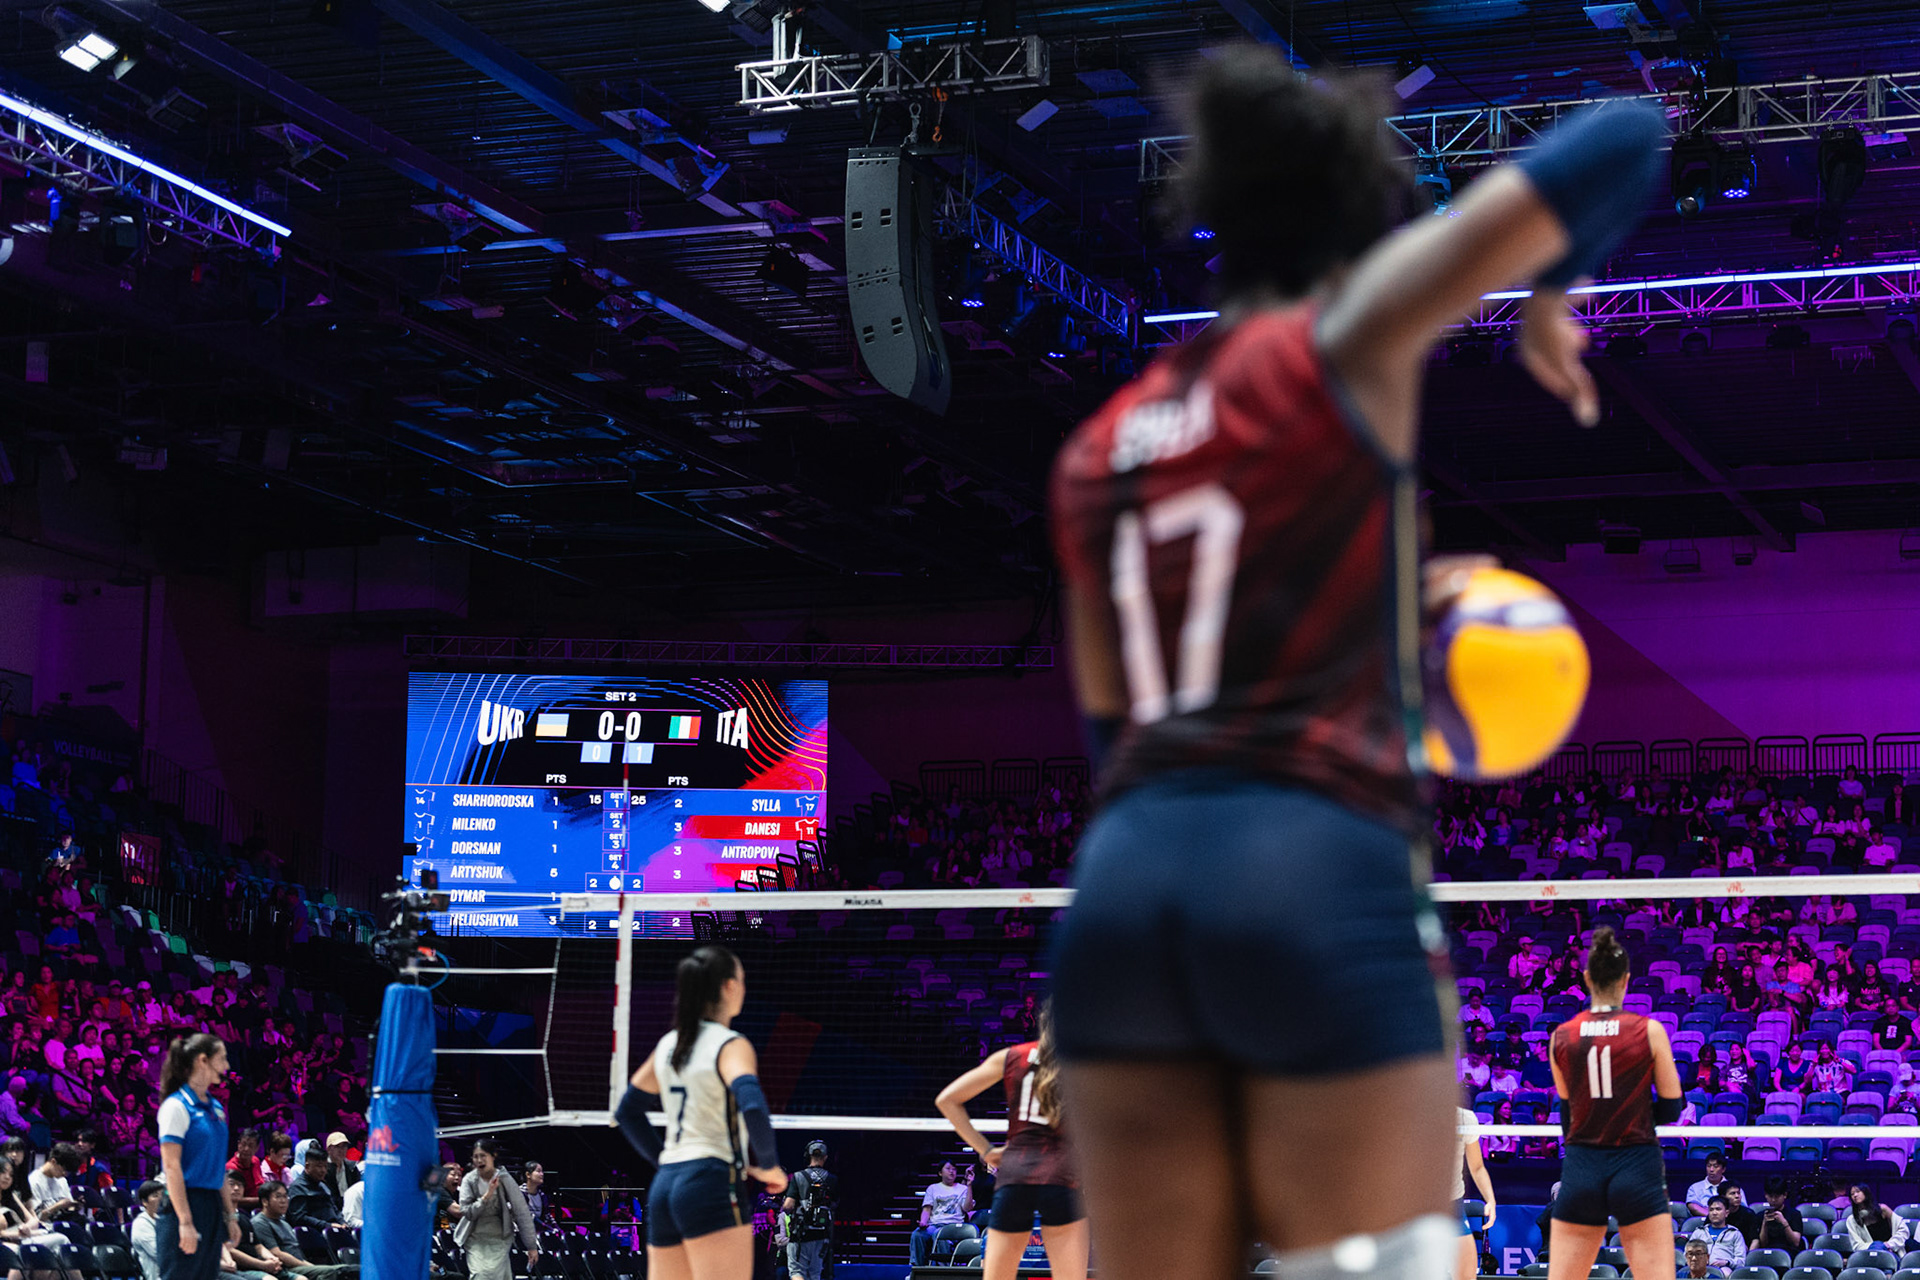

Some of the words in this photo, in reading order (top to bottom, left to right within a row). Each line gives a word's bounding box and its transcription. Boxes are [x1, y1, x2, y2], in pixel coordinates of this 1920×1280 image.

[1110, 484, 1247, 725] 17
[605, 692, 627, 701] SET
[628, 692, 637, 701] 2
[477, 700, 525, 746] UKR
[598, 711, 642, 741] 0-0
[716, 707, 749, 749] ITA
[592, 745, 602, 760] 0
[636, 746, 643, 760] 1
[546, 774, 567, 783] PTS
[668, 776, 689, 785] PTS
[415, 797, 426, 805] 14
[453, 794, 534, 808] SHARHORODSKA
[553, 797, 559, 806] 1
[589, 795, 602, 805] 15
[614, 800, 619, 808] 1
[631, 795, 647, 805] 25
[674, 799, 683, 808] 2
[751, 799, 781, 812] SYLLA
[805, 803, 815, 811] 17
[418, 821, 422, 829] 1
[452, 818, 496, 831] MILENKO
[552, 820, 558, 830] 1
[612, 819, 620, 829] 2
[674, 822, 682, 832] 3
[744, 823, 781, 835] DANESI
[806, 827, 814, 835] 11
[416, 844, 422, 853] 7
[451, 841, 502, 855] DORSMAN
[552, 844, 558, 853] 1
[612, 840, 620, 849] 3
[124, 842, 145, 869] 114
[673, 846, 682, 855] 3
[721, 845, 780, 859] ANTROPOVA
[611, 861, 619, 870] 4
[450, 866, 504, 879] ARTYSHUK
[550, 868, 558, 877] 5
[673, 870, 681, 879] 3
[589, 878, 598, 888] 2
[632, 879, 641, 889] 2
[450, 889, 486, 903] DYMAR
[551, 892, 556, 901] 1
[549, 916, 557, 925] 3
[588, 920, 597, 930] 2
[632, 921, 640, 930] 2
[672, 917, 681, 927] 2
[1587, 1045, 1613, 1099] 11
[670, 1086, 687, 1143] 7
